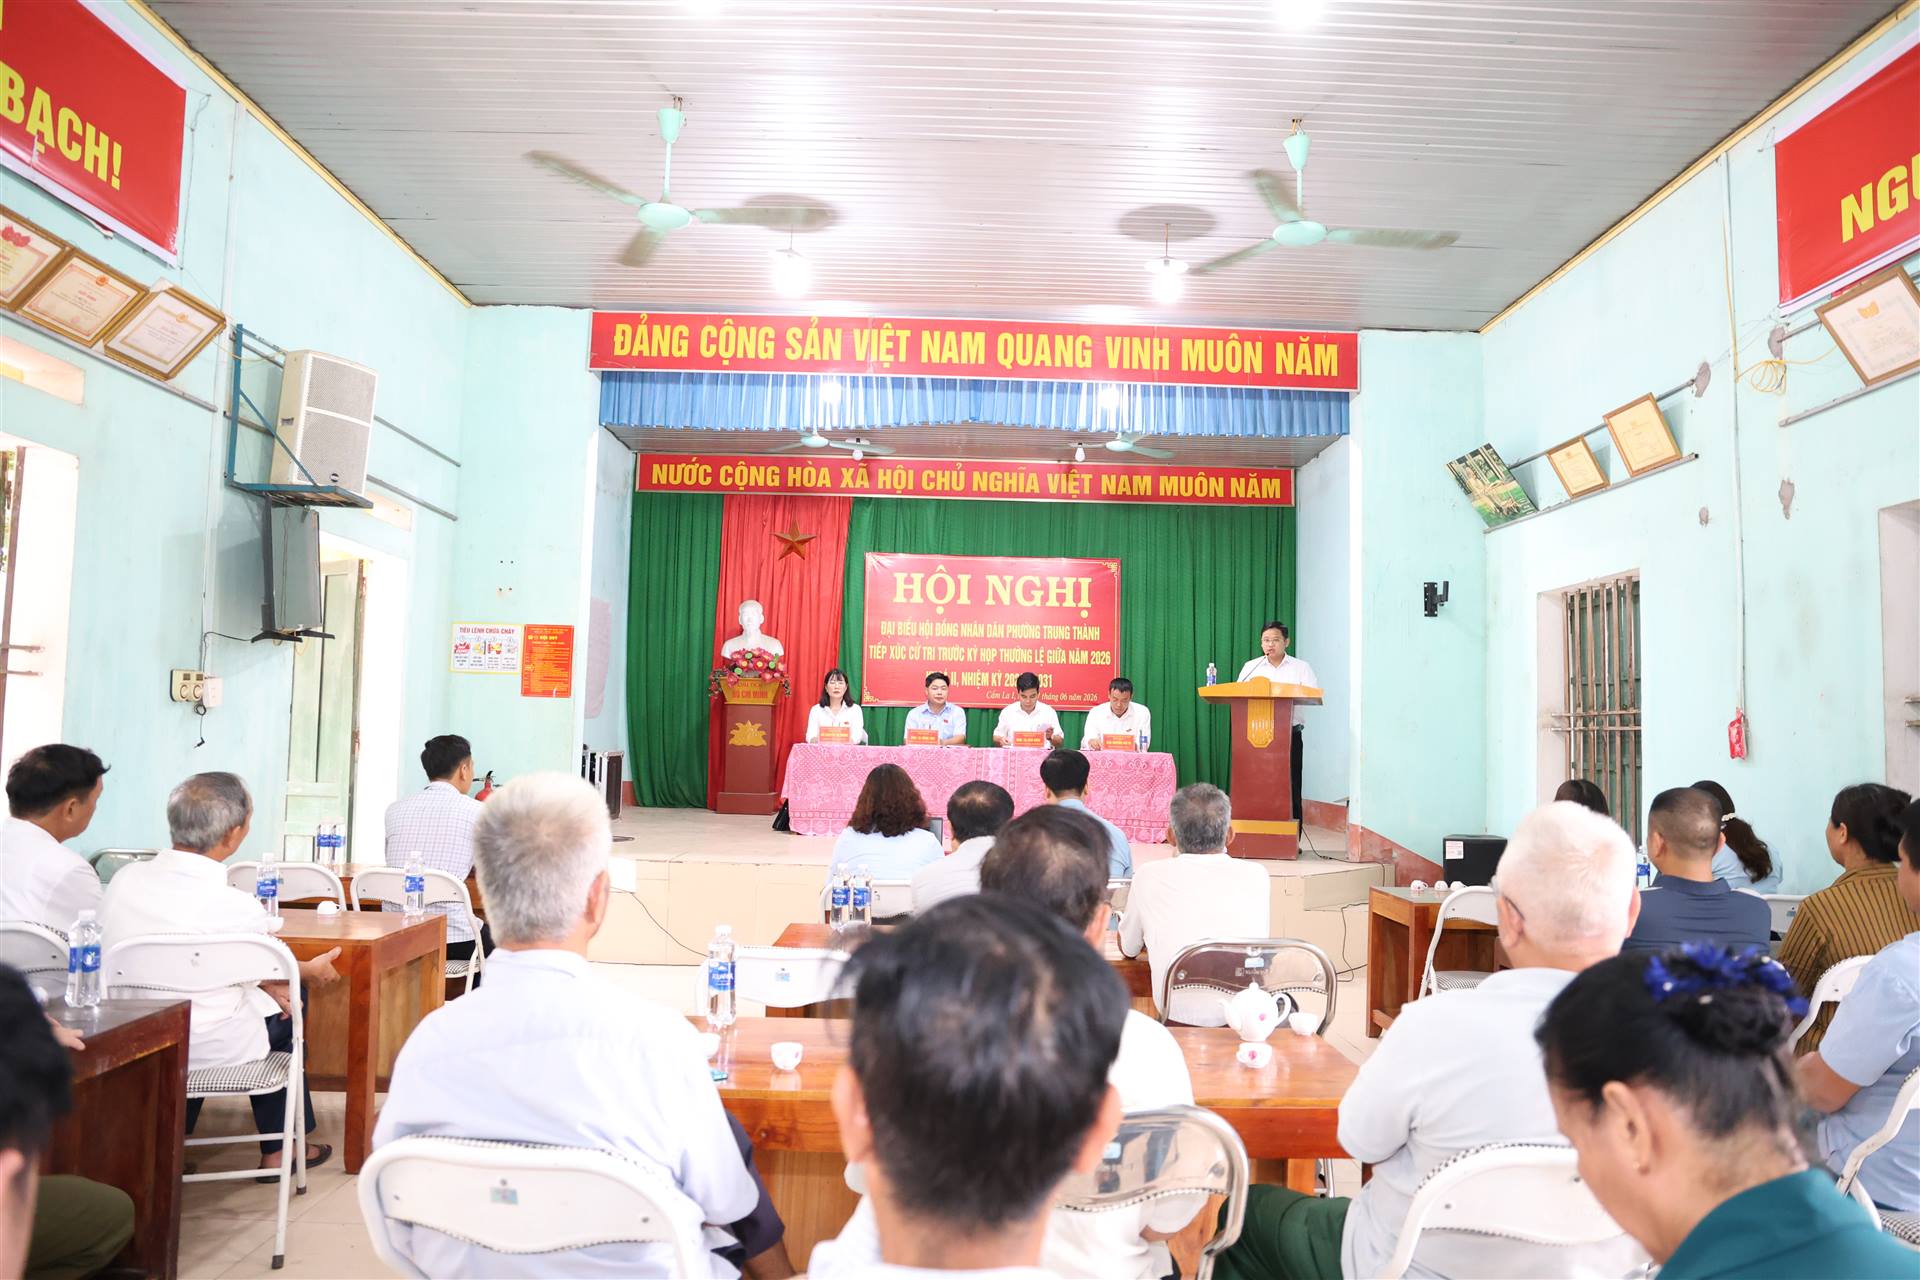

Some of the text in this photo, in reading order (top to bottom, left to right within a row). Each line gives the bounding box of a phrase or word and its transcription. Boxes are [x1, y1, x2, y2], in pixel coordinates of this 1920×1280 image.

[0, 61, 122, 190] BẠCH!
[614, 313, 1338, 377] ĐẢNG CỘNG SẢN VIỆT NAM QUANG VINH MUÔN NĂM
[652, 456, 1281, 499] NƯỚC CỘNG HÒA XÃ HỘI CHỦ NGHĨA VIỆT NAM MUÔN NĂM
[892, 564, 1092, 619] HỘI NGHỊ
[881, 617, 1100, 641] ĐẠI BIỂU HỘI ĐỒNG NHÂN DÂN PHƯỜNG TRUNG THÀNH
[869, 641, 887, 660] TIẾP
[889, 643, 906, 660] XÚC
[908, 641, 920, 660] CỬ
[923, 646, 936, 661] TRI
[938, 644, 965, 662] TRƯỚC
[980, 648, 997, 666] HỌP
[1000, 646, 1032, 663] THƯỜNG
[1035, 646, 1044, 667] LỆ
[1047, 647, 1066, 664] GIỮA
[1069, 647, 1089, 665] NĂM
[1090, 651, 1111, 665] 2026
[961, 669, 989, 689] NHIỆM
[1042, 693, 1059, 702] tháng
[1069, 693, 1082, 701] năm
[1083, 693, 1098, 701] 2026
